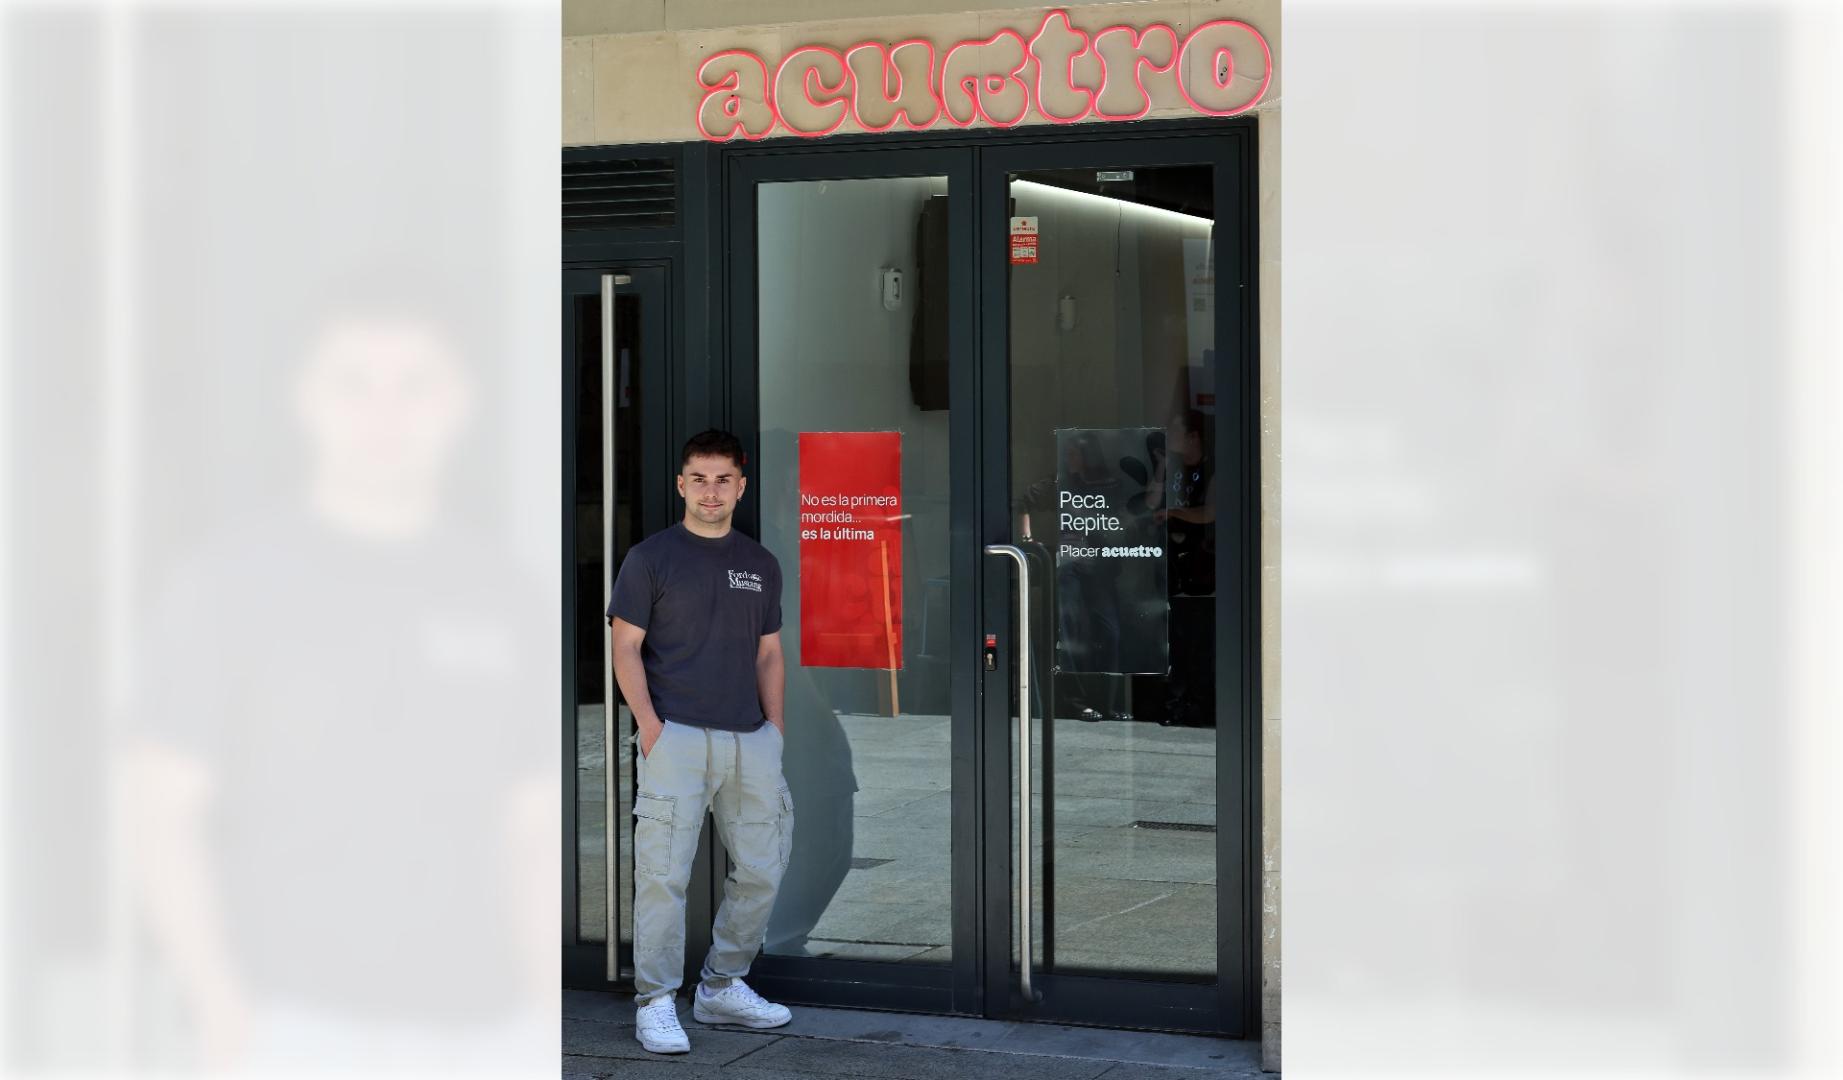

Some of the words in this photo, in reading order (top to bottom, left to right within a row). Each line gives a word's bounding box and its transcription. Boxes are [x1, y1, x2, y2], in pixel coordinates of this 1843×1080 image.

[801, 493, 819, 506] No
[821, 495, 837, 506] es
[838, 493, 849, 506] la
[850, 494, 898, 510] primera
[1060, 491, 1110, 509] Peca.
[801, 510, 861, 523] mordida...
[1060, 513, 1124, 536] Repite.
[801, 529, 818, 540] es
[820, 527, 831, 540] la
[833, 526, 874, 540] última
[1060, 544, 1100, 558] Placer
